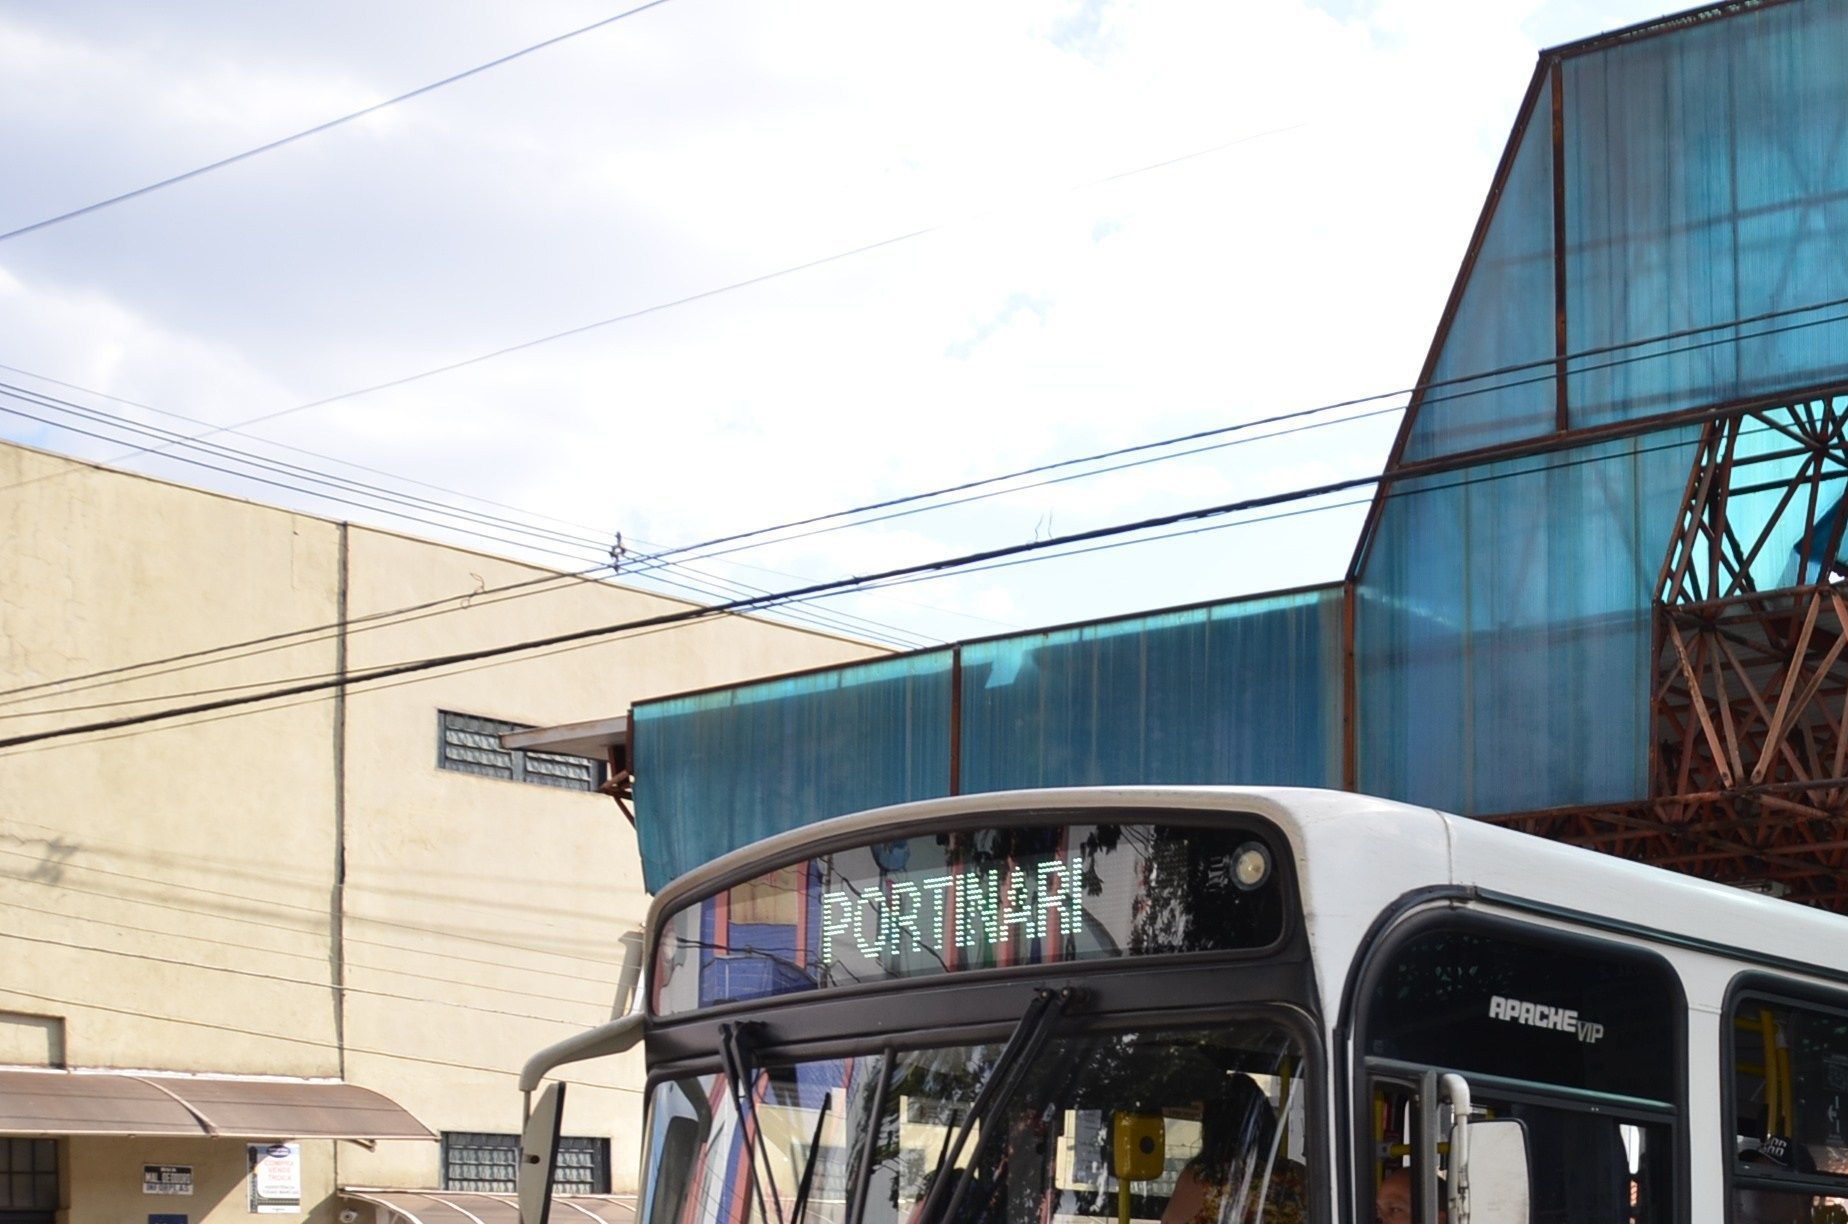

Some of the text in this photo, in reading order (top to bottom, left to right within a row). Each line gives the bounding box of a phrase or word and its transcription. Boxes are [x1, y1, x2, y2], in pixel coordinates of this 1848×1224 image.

[823, 857, 1083, 963] PORTINARI
[1489, 995, 1604, 1044] APACHE VIP
